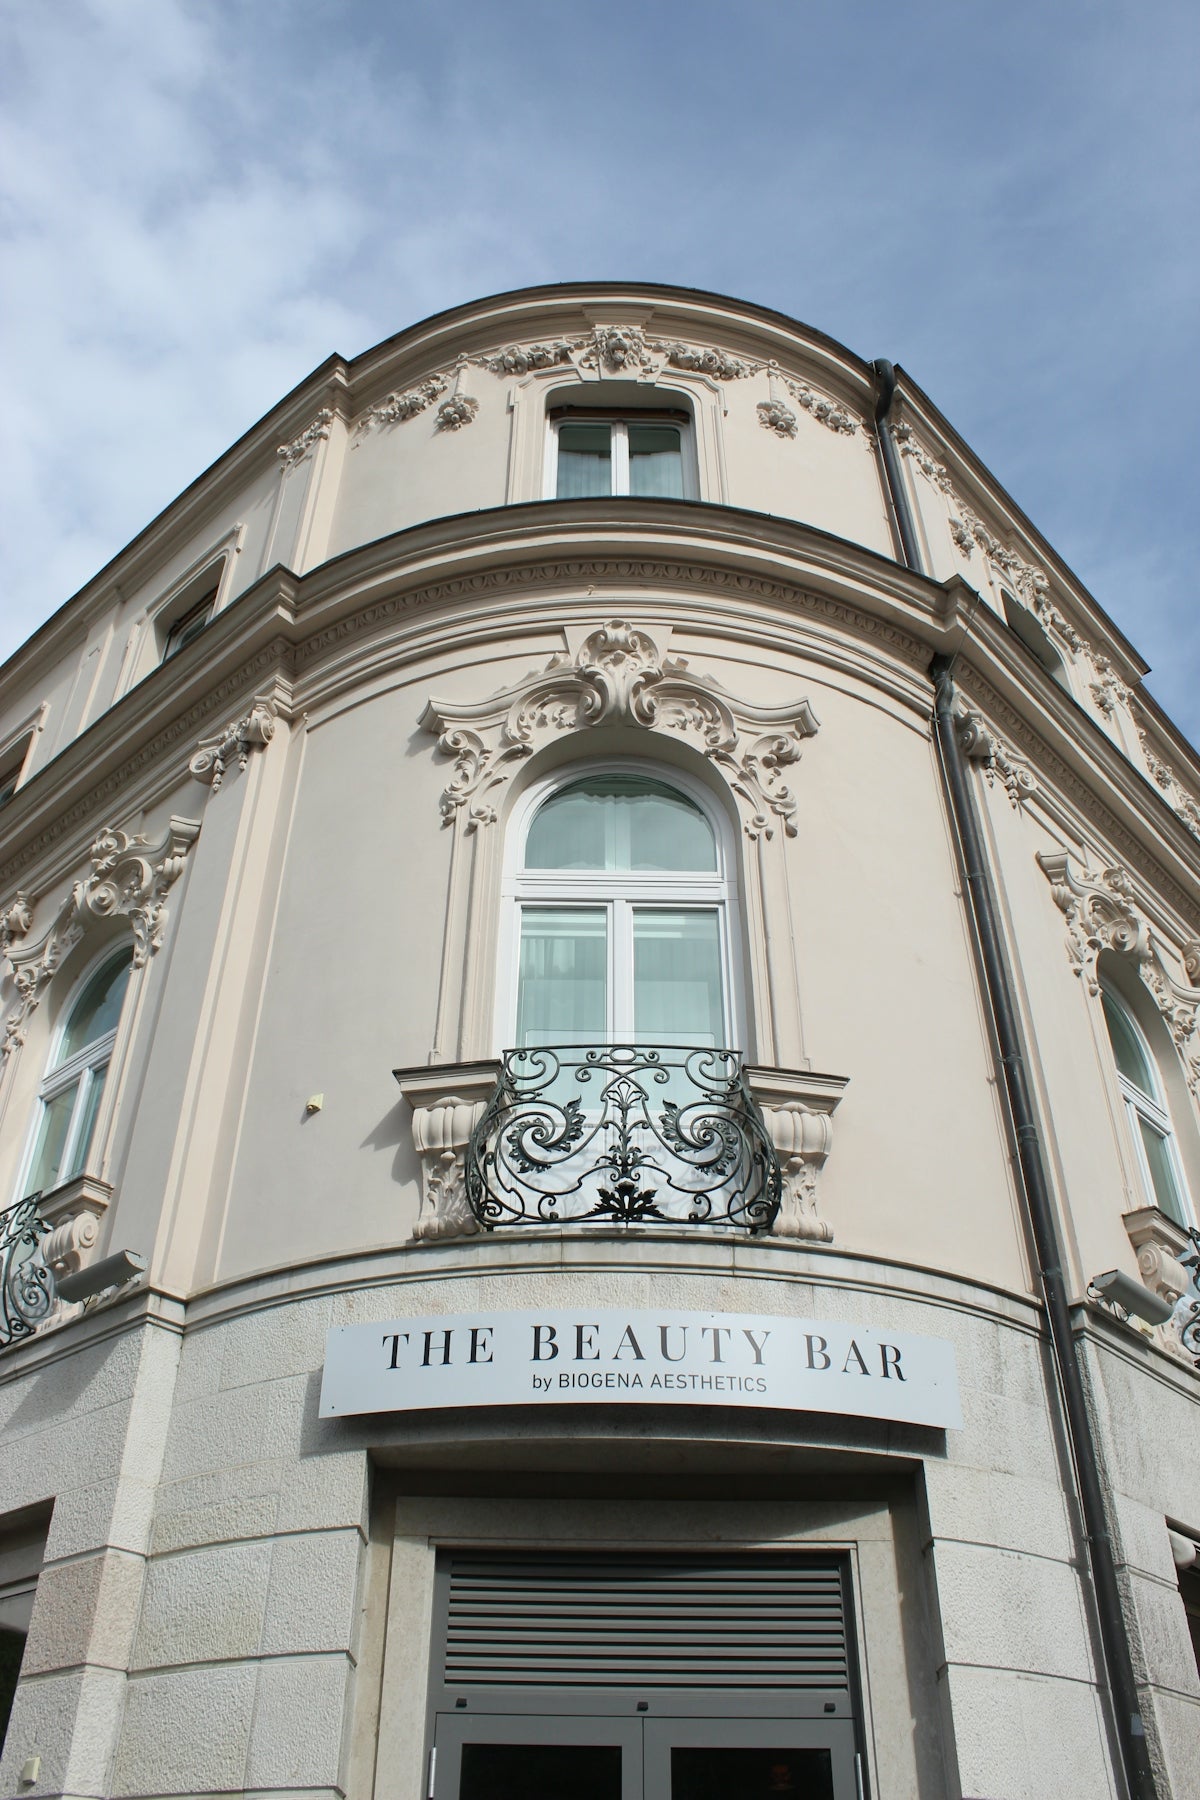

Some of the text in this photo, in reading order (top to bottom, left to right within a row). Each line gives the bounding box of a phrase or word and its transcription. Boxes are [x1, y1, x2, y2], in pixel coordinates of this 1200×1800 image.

[381, 1324, 908, 1382] THE BEAUTY BAR
[532, 1372, 768, 1393] by BIOGENA AESTHETICS
